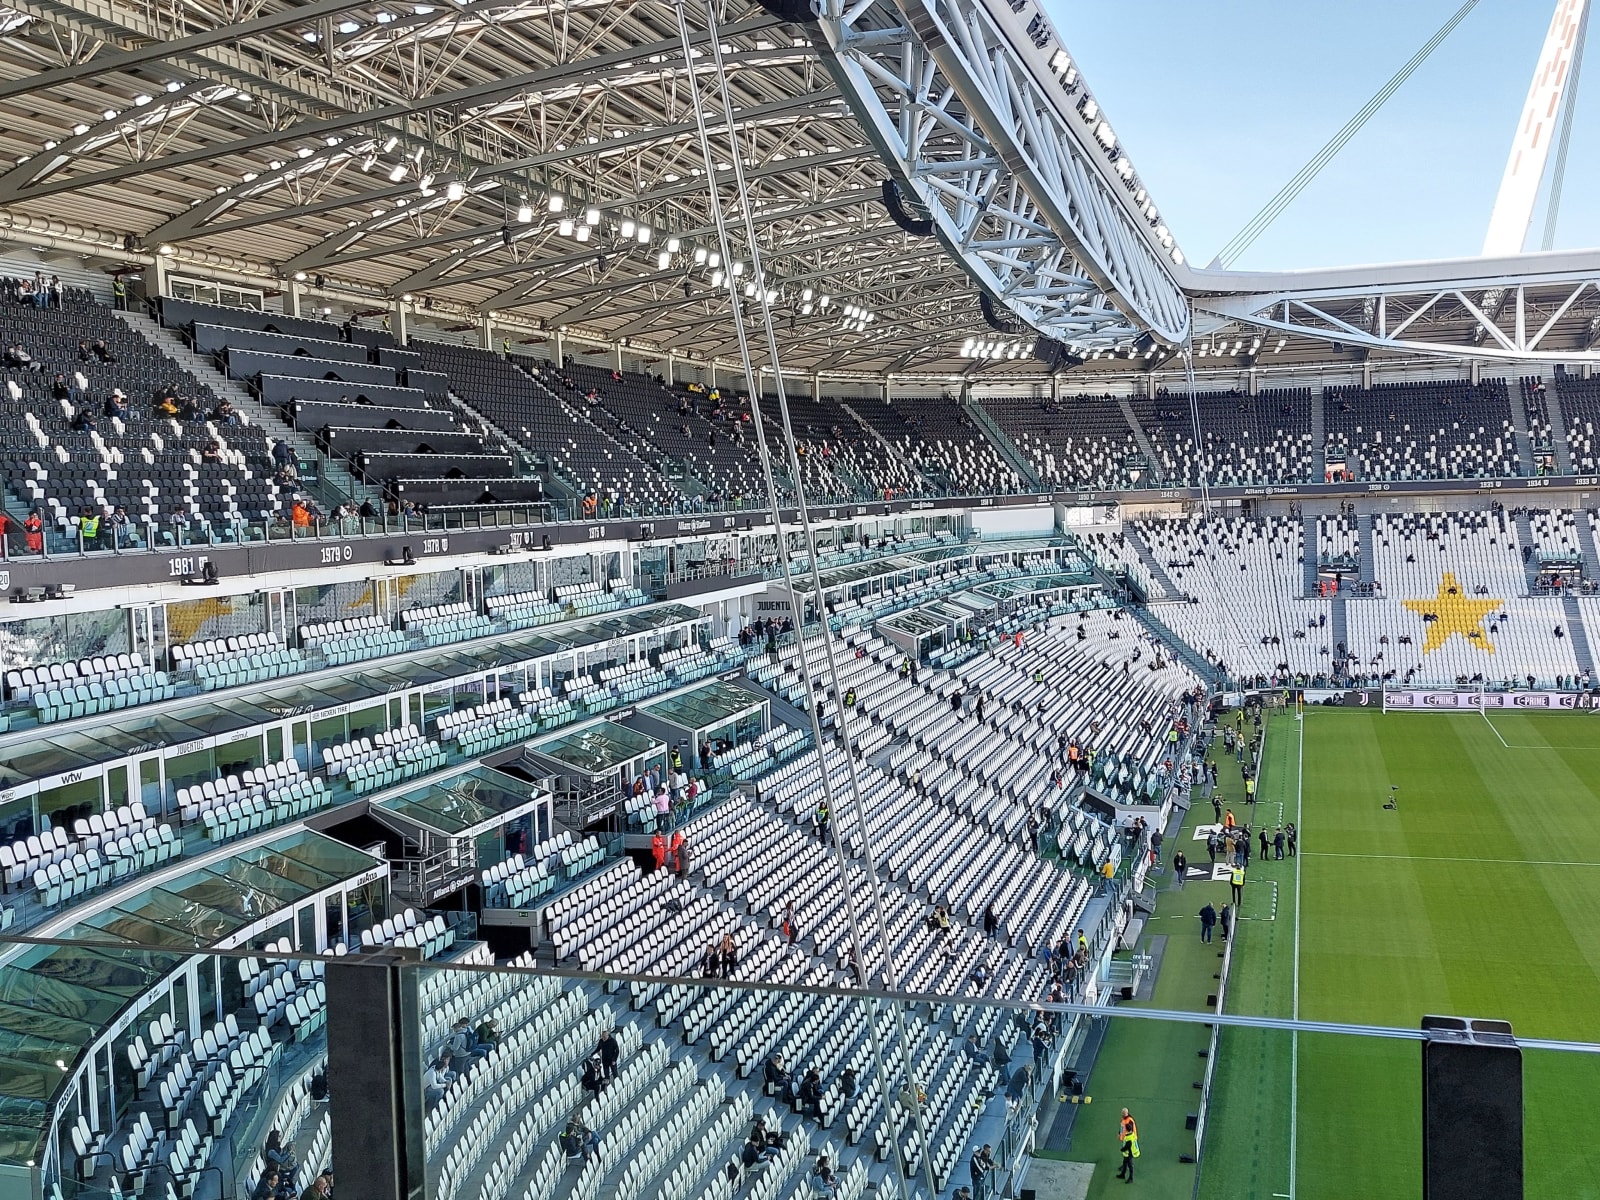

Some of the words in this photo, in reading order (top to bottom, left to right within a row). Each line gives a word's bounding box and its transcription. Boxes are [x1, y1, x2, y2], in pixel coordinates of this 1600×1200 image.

[423, 538, 440, 554] 1978
[320, 546, 341, 563] 1979
[168, 556, 196, 577] 1981
[757, 600, 790, 611] JUVENTU
[320, 707, 337, 718] NEXEN
[337, 704, 348, 714] TIRE
[176, 739, 204, 756] JUVENTUS
[61, 771, 82, 785] wtw
[433, 886, 450, 899] Allianz
[456, 874, 475, 889] Stadium
